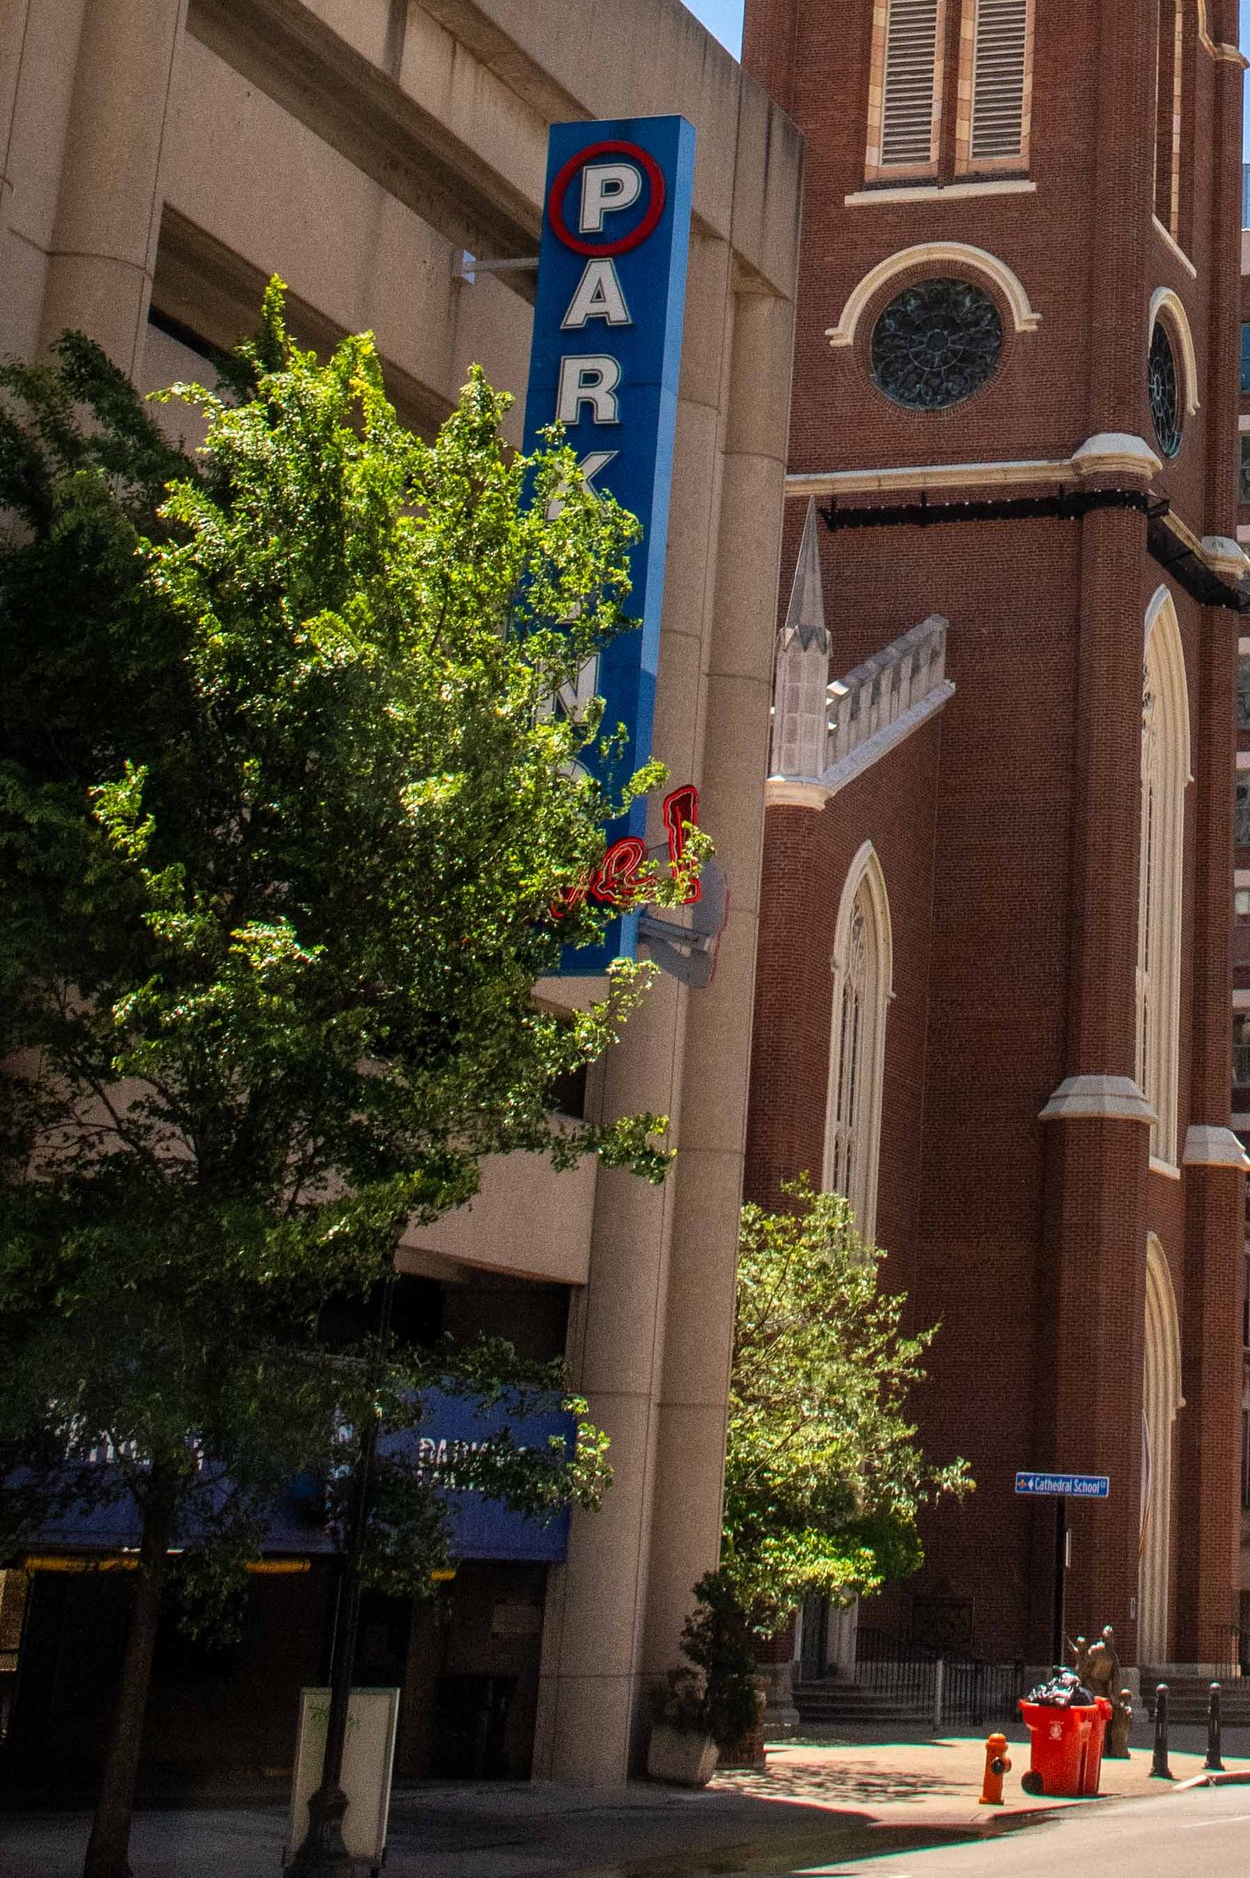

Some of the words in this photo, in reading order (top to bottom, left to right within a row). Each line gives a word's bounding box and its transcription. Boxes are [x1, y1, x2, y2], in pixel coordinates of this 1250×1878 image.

[529, 162, 643, 822] PARKN
[1034, 1477, 1073, 1493] Cathedral
[1073, 1479, 1100, 1494] School
